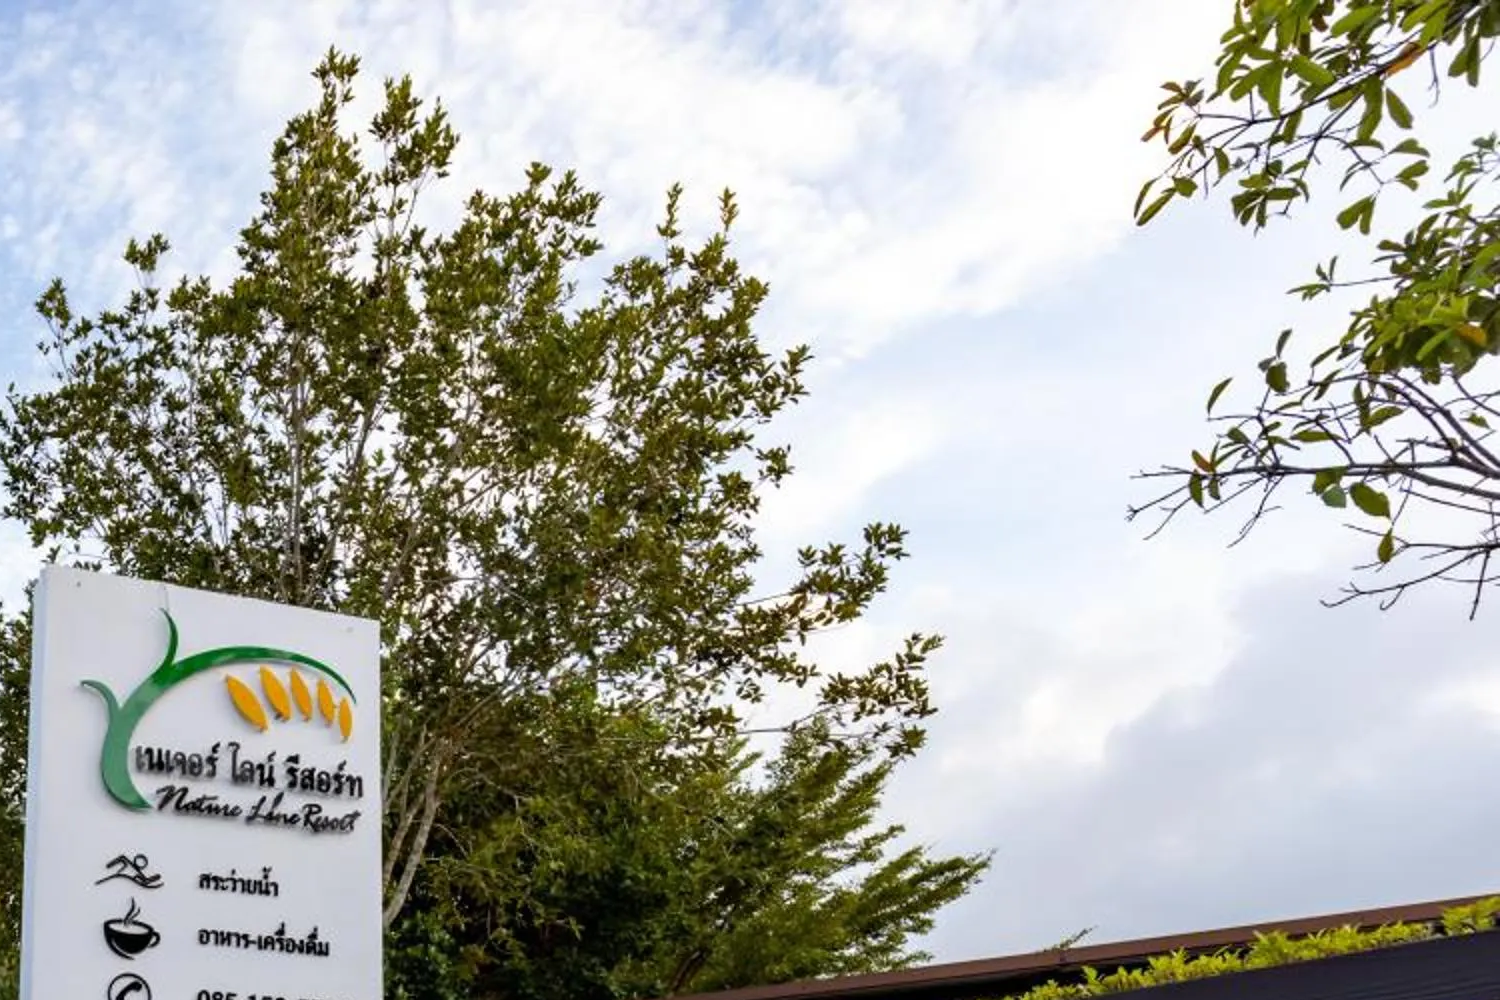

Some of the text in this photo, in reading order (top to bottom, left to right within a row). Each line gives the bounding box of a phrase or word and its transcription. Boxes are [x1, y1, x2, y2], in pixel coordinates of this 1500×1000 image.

[228, 741, 275, 787] ไลน์
[284, 754, 363, 798] รีสอร์ท
[156, 784, 361, 833] Nature Line Resort
[199, 867, 279, 897] สระว่ายน้ำ
